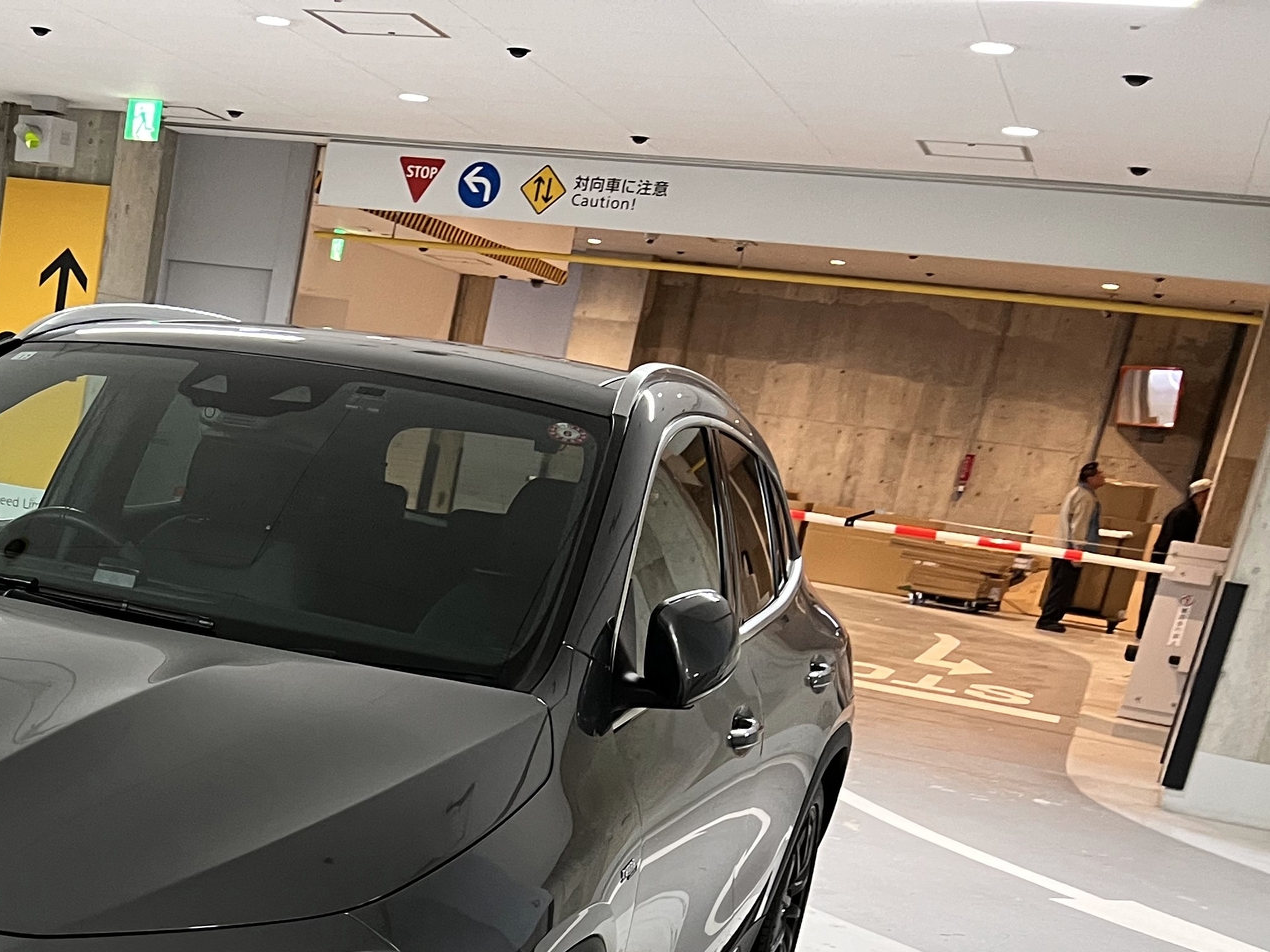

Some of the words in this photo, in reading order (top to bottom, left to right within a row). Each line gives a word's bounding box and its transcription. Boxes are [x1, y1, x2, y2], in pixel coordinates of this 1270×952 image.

[406, 165, 438, 179] STOP
[574, 175, 670, 198] 対向車に注意
[571, 193, 636, 211] Caution!
[23, 498, 41, 510] Lim
